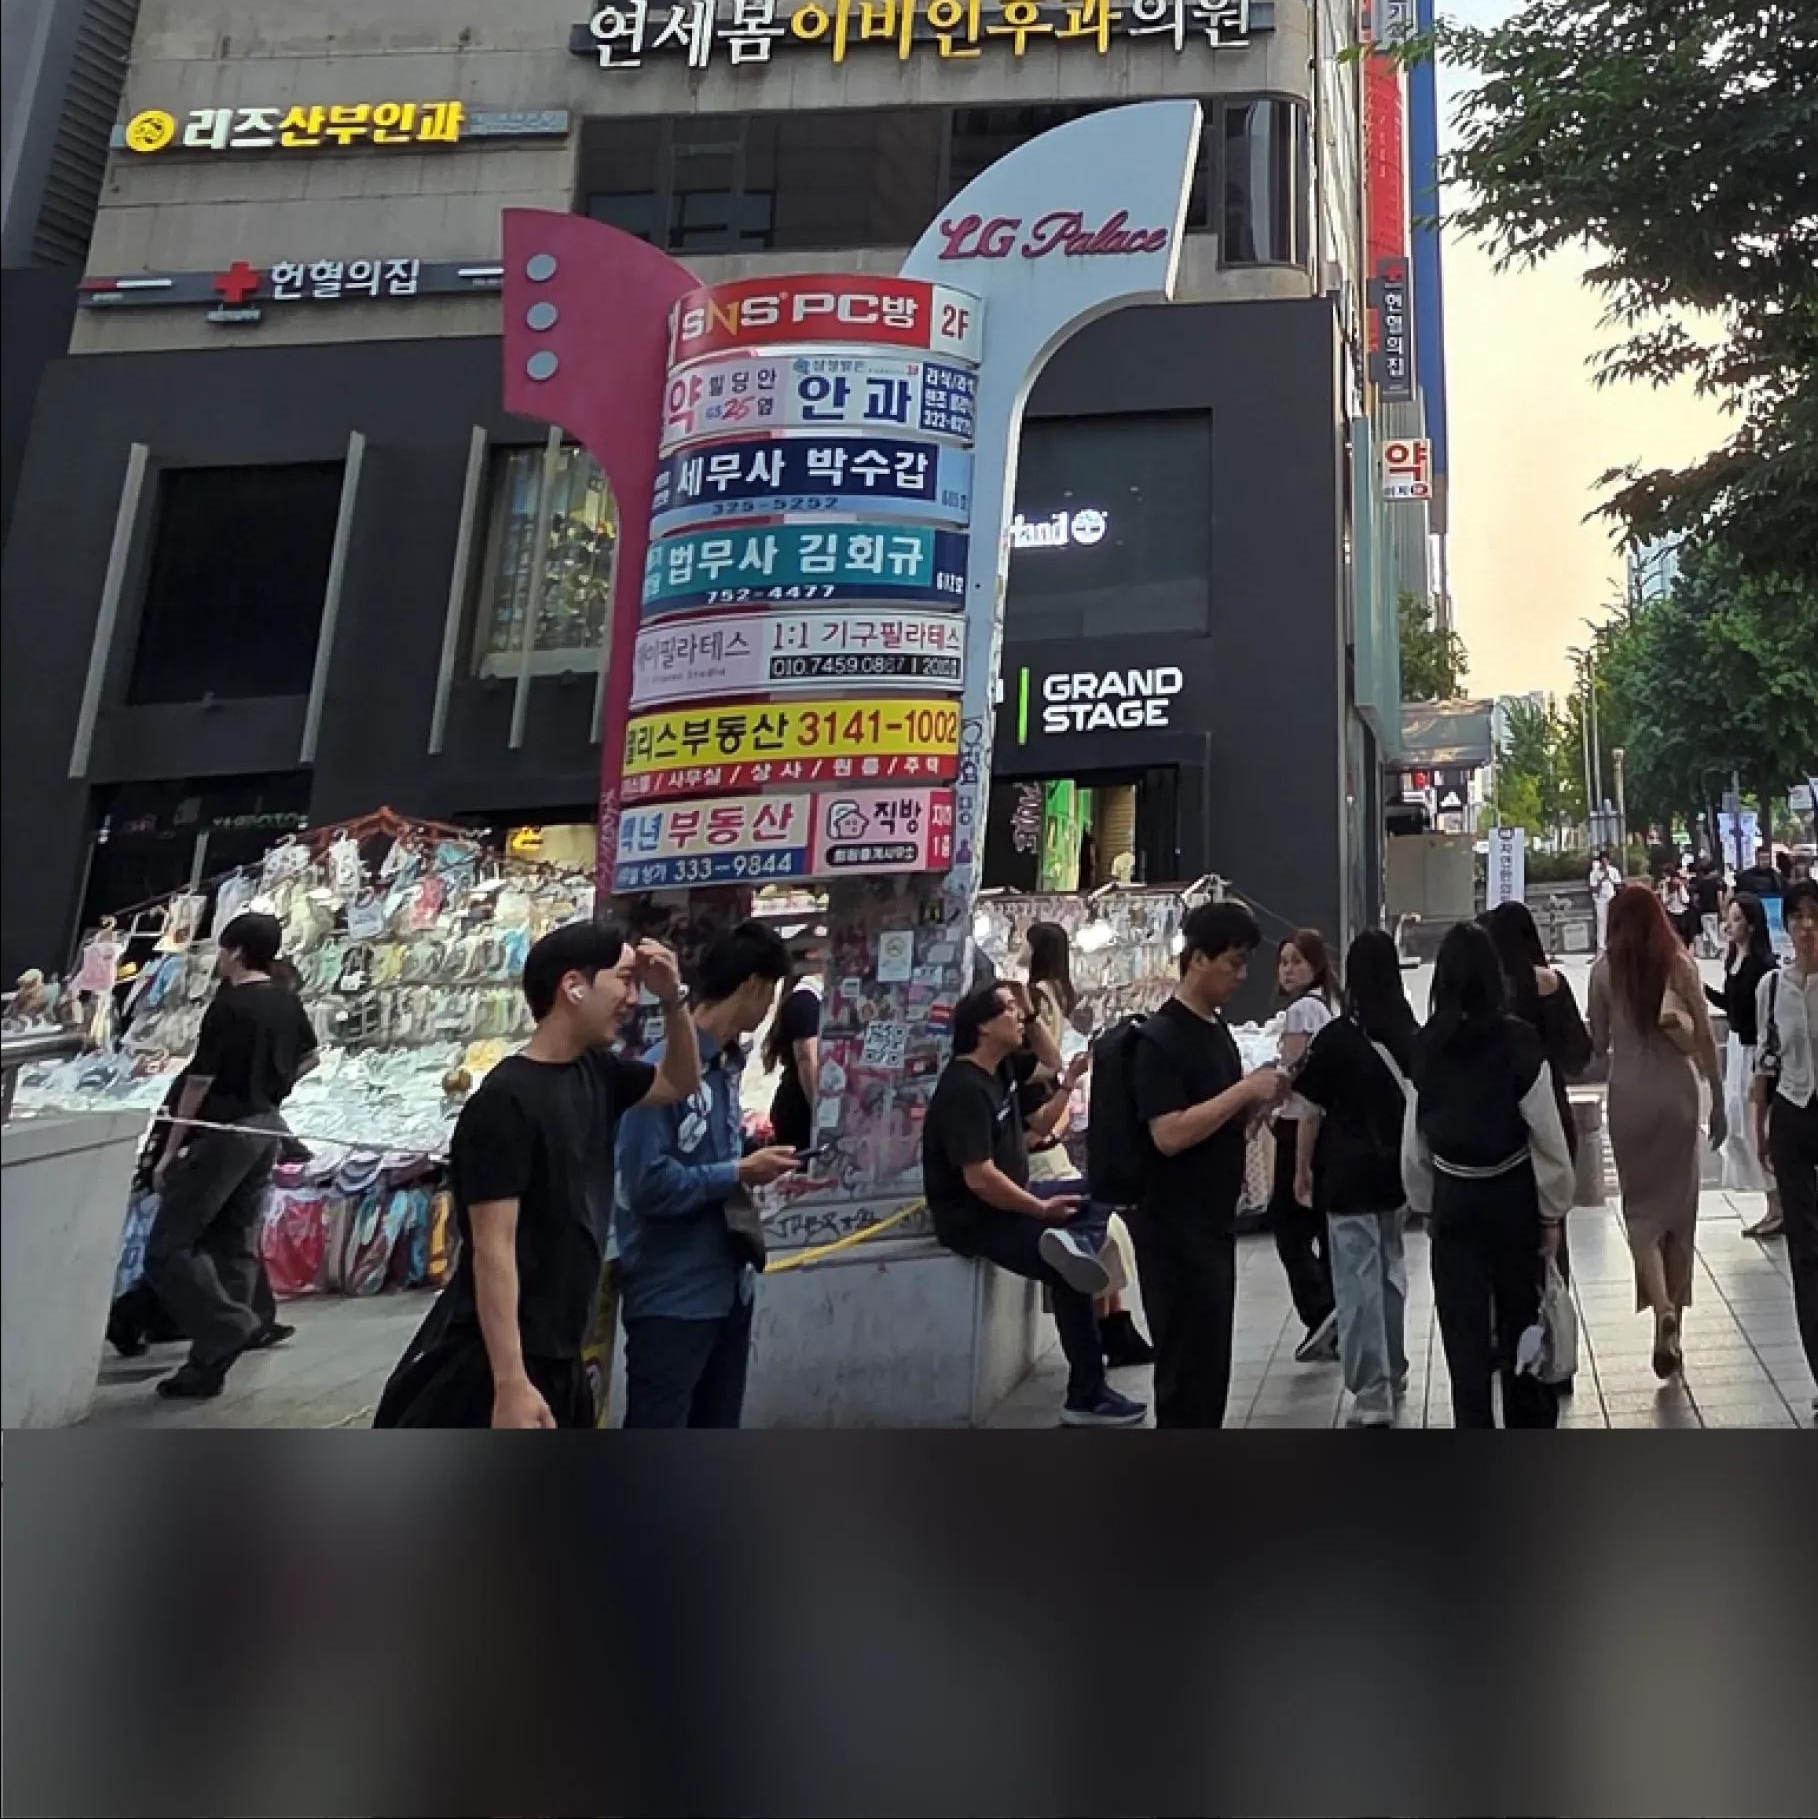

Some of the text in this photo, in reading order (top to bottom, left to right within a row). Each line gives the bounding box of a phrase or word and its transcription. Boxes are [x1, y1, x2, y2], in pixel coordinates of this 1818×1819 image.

[182, 100, 465, 150] 리즈산부인과
[938, 209, 1170, 261] LG Palace
[791, 292, 919, 329] PC방
[940, 303, 970, 341] 2F
[667, 374, 703, 435] 약
[797, 375, 913, 425] 안과
[677, 447, 786, 497] 세무사
[806, 447, 930, 490] 박수갑
[1384, 440, 1428, 482] 약
[668, 534, 779, 586] 법무사
[798, 533, 925, 577] 김회규
[773, 620, 961, 652] 1:1 기구필라테스
[1042, 666, 1184, 701] GRAND
[797, 708, 957, 747] 3141-1002
[1042, 697, 1170, 734] STAGE
[668, 802, 794, 850] 부동산
[873, 798, 922, 835] 직방
[673, 852, 793, 882] 333-9844
